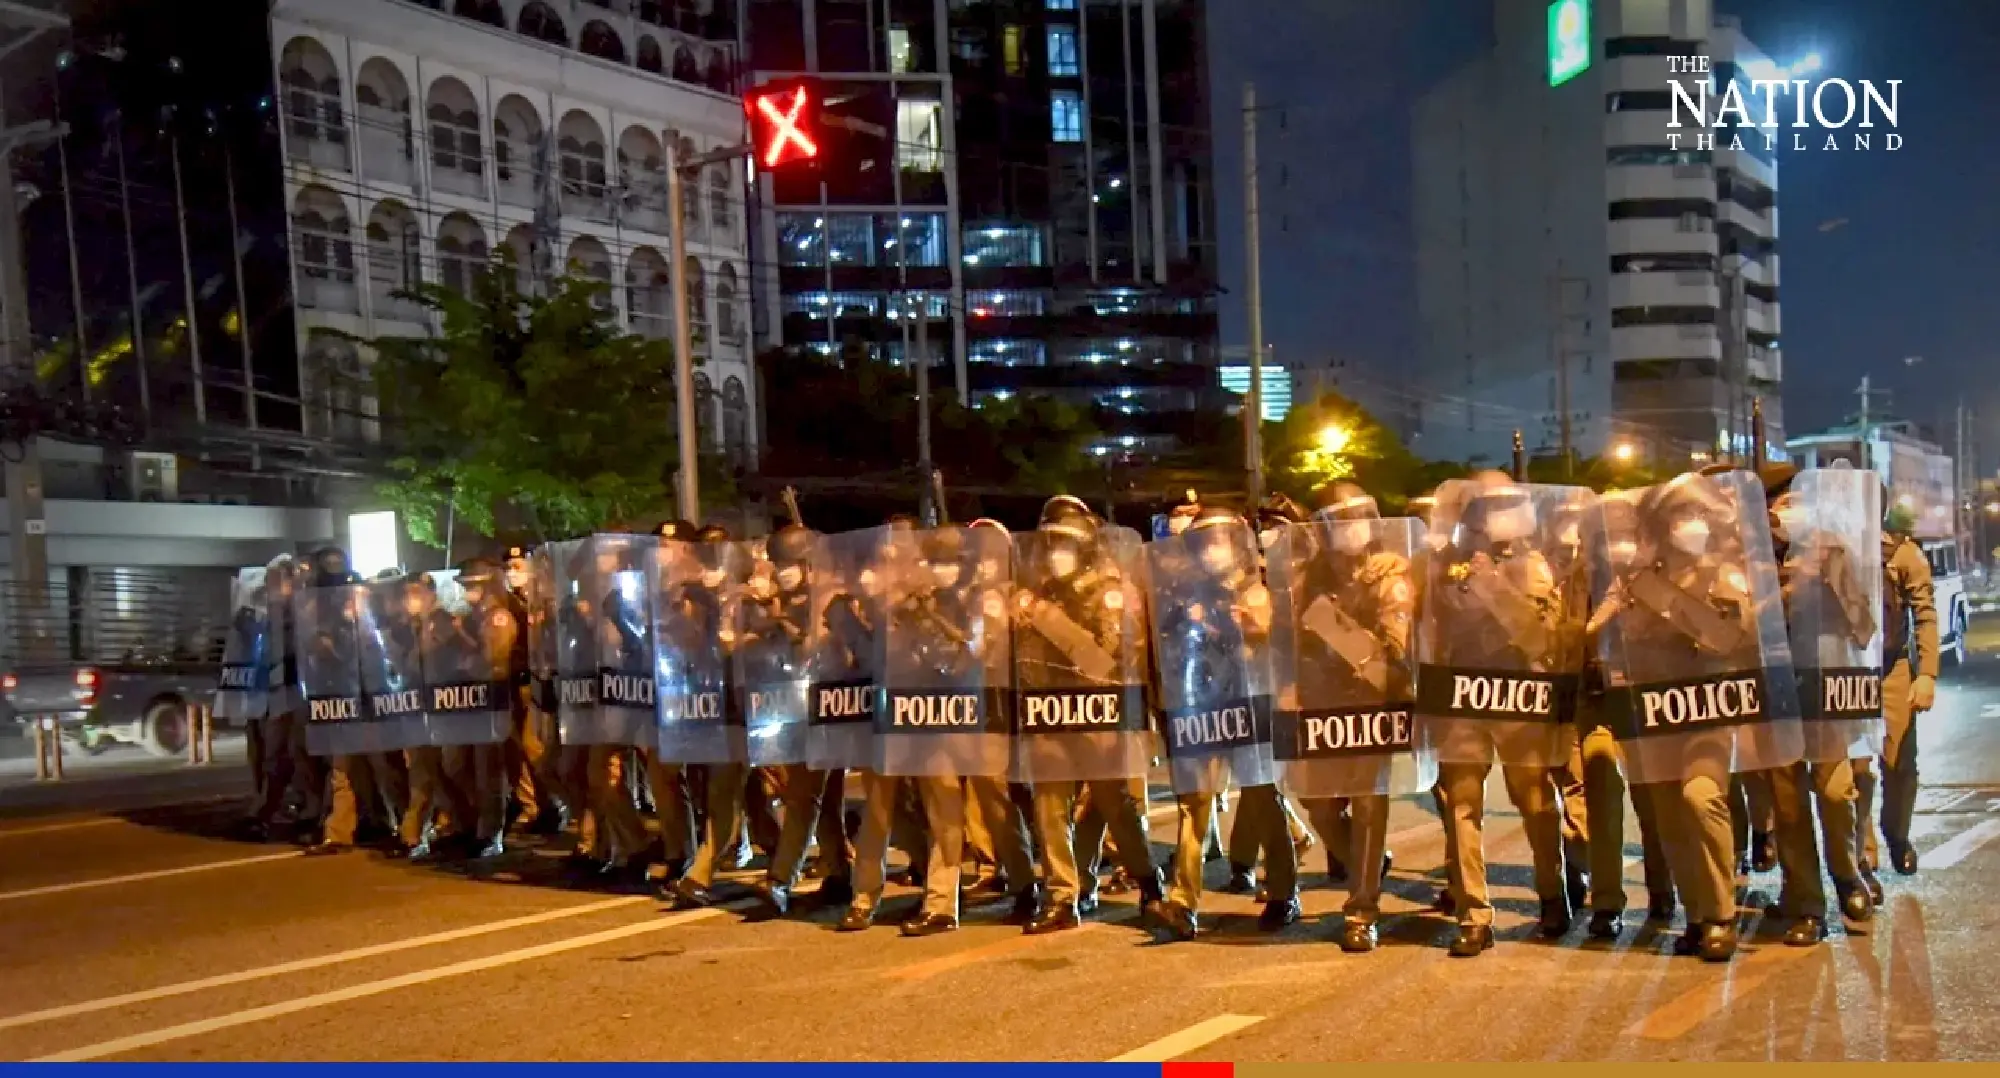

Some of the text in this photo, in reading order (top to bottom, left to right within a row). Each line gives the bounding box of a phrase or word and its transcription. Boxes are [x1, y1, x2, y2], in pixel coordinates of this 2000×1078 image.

[310, 697, 359, 720] POLICE
[373, 689, 420, 717] POLICE
[434, 684, 488, 709] POLICE
[893, 694, 978, 726] POLICE
[1026, 693, 1120, 726] POLICE
[1452, 675, 1553, 715] POLICE
[1642, 678, 1760, 728] POLICE
[1823, 675, 1880, 713] POLICE
[1172, 706, 1250, 747] POLICE
[1305, 710, 1410, 751] POLICE
